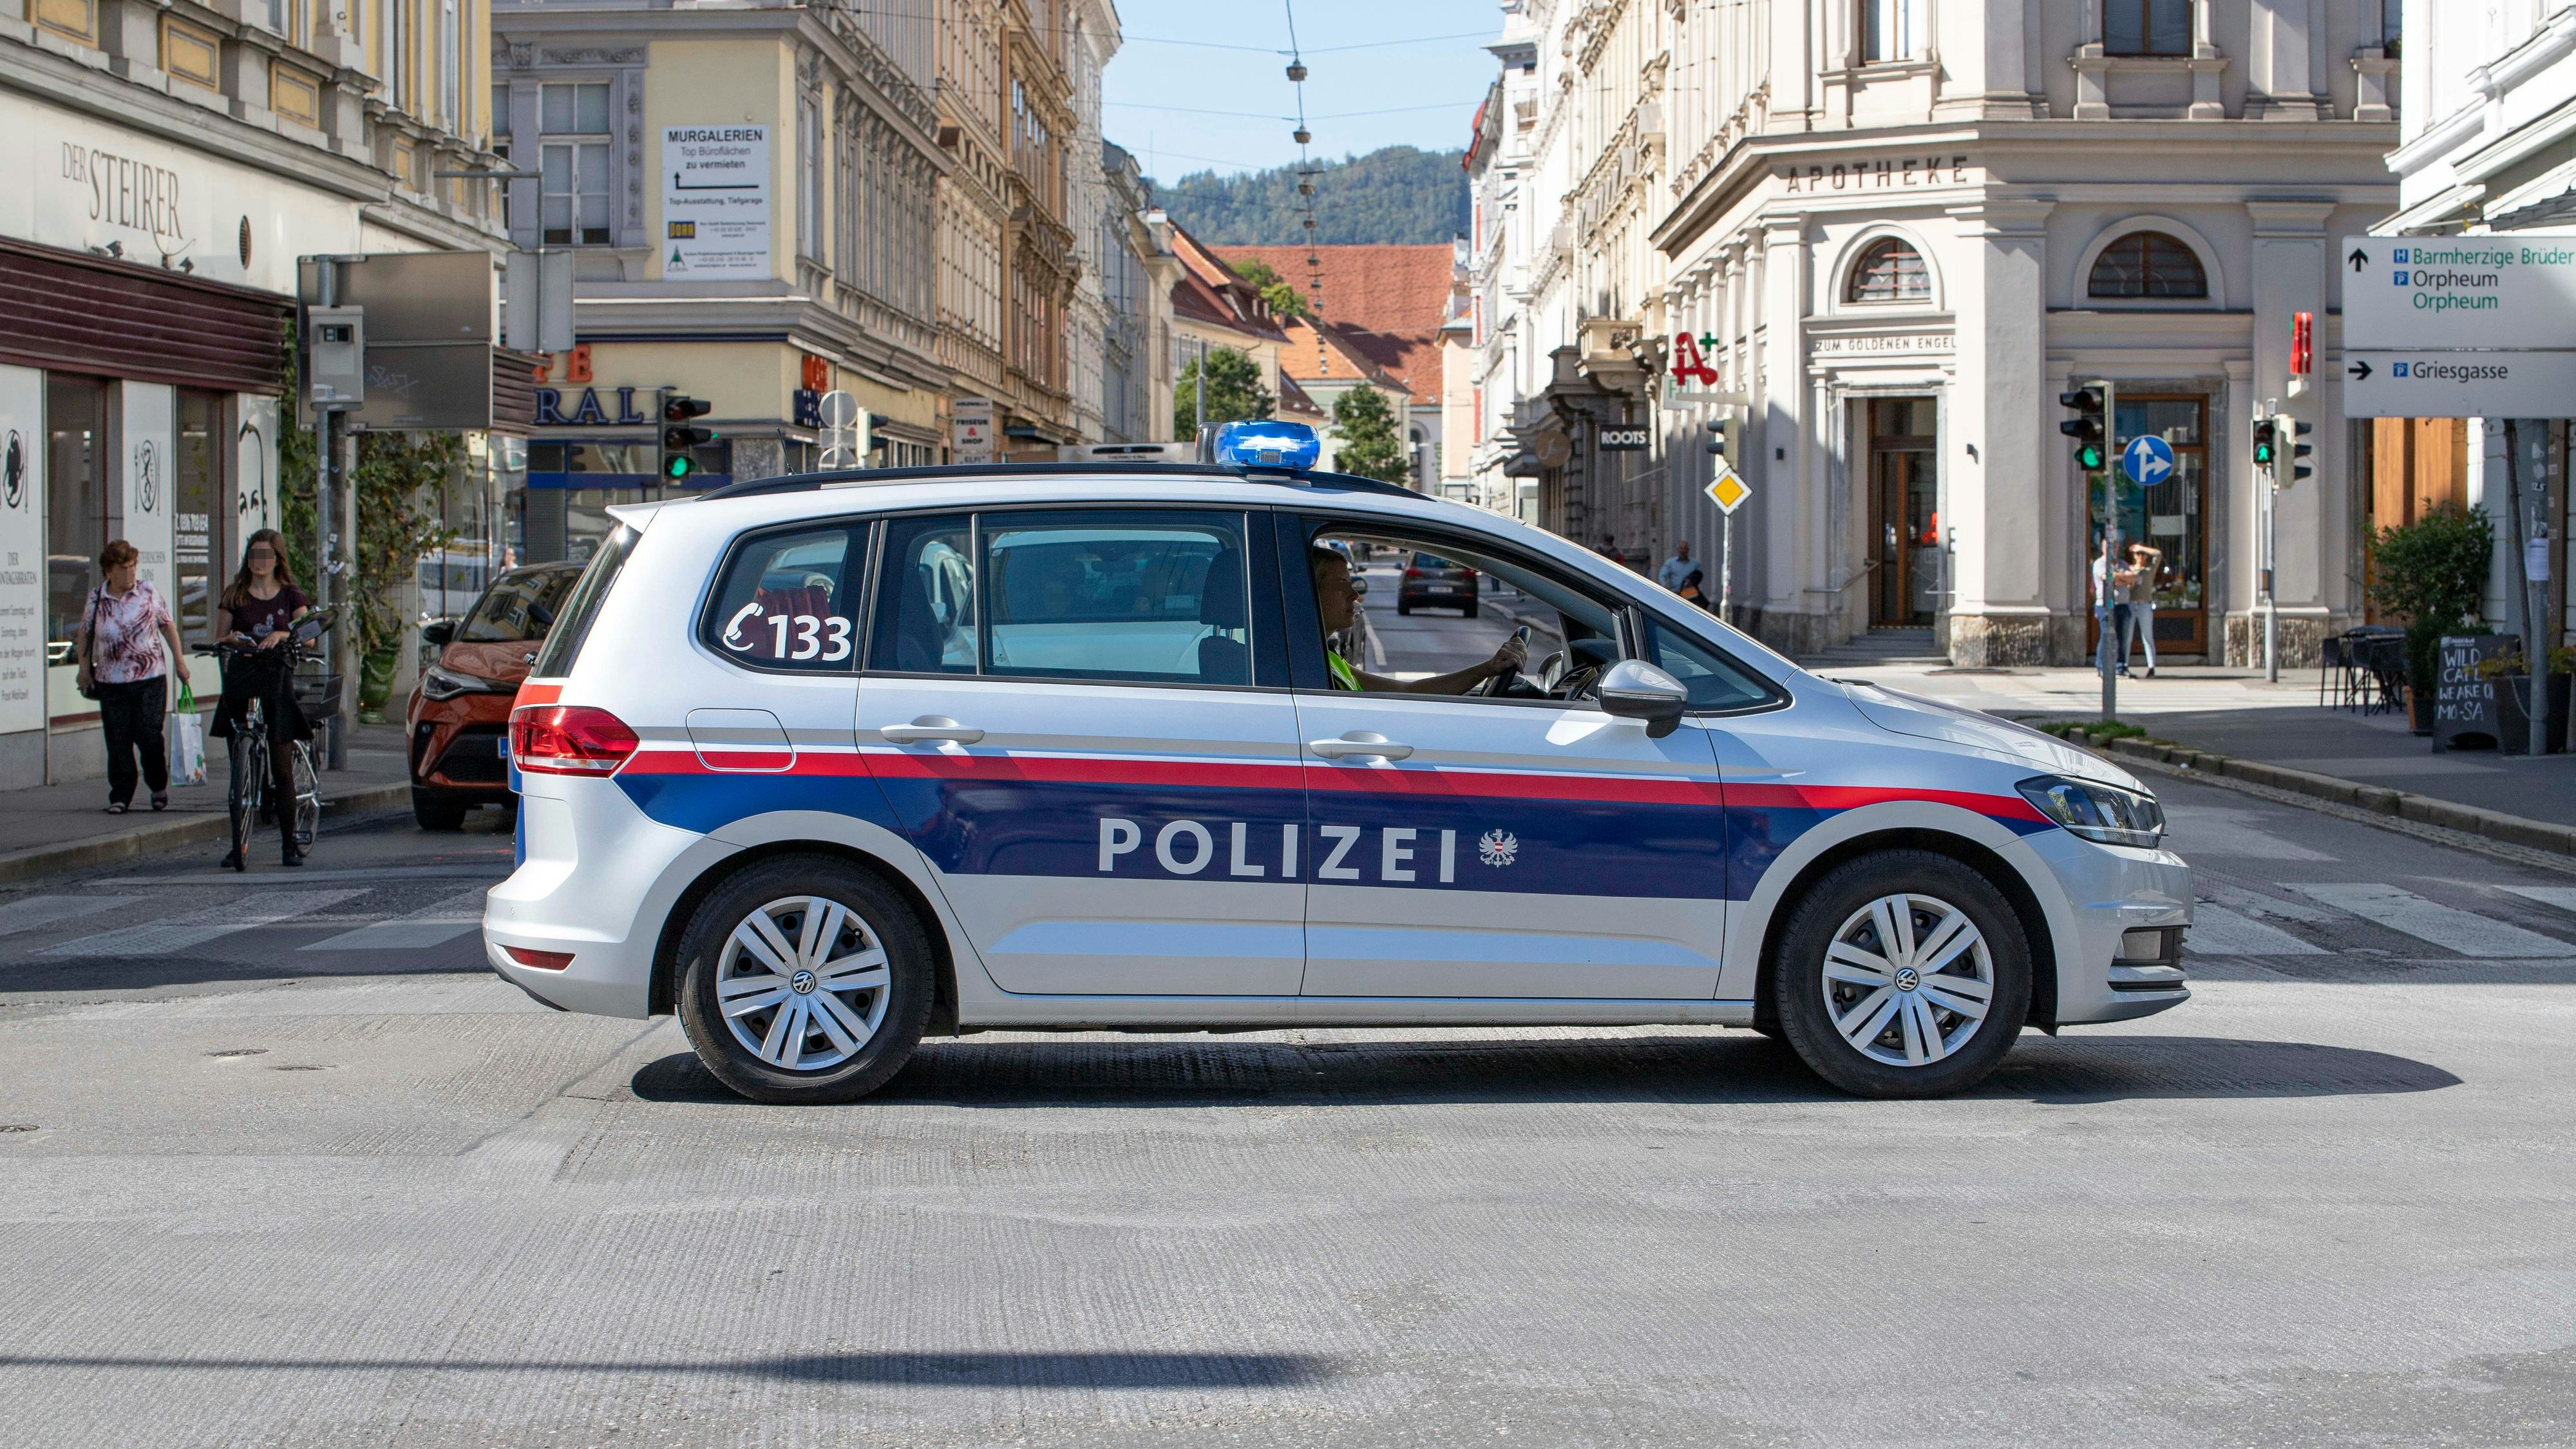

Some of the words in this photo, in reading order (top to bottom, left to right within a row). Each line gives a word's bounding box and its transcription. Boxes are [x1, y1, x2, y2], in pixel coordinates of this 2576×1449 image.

[668, 129, 763, 142] MURGALERIEN
[681, 147, 697, 156] Top
[699, 146, 751, 156] Büroflächen
[699, 160, 746, 169] vermieten
[1787, 156, 1967, 193] APOTHEKE
[62, 140, 88, 184] DER
[90, 149, 194, 256] STEIRER
[2413, 247, 2514, 269] Barmherzige
[2521, 247, 2575, 265] Brüder
[2413, 269, 2498, 291] Orpheum
[2413, 292, 2498, 313] Orpheum
[1815, 339, 1841, 352] ZUM
[1848, 339, 1910, 350] GOLDENEN
[1918, 337, 1956, 349] ENGEL
[2413, 361, 2508, 383] Griesgasse
[1601, 431, 1647, 444] ROOTS
[8, 552, 19, 566] DER
[767, 614, 852, 662] 133
[2445, 648, 2481, 667] WILD
[2438, 687, 2454, 700] WE
[2456, 685, 2480, 700] ARE
[2438, 701, 2484, 721] MO-SA
[1099, 818, 1456, 883] POLIZEI
